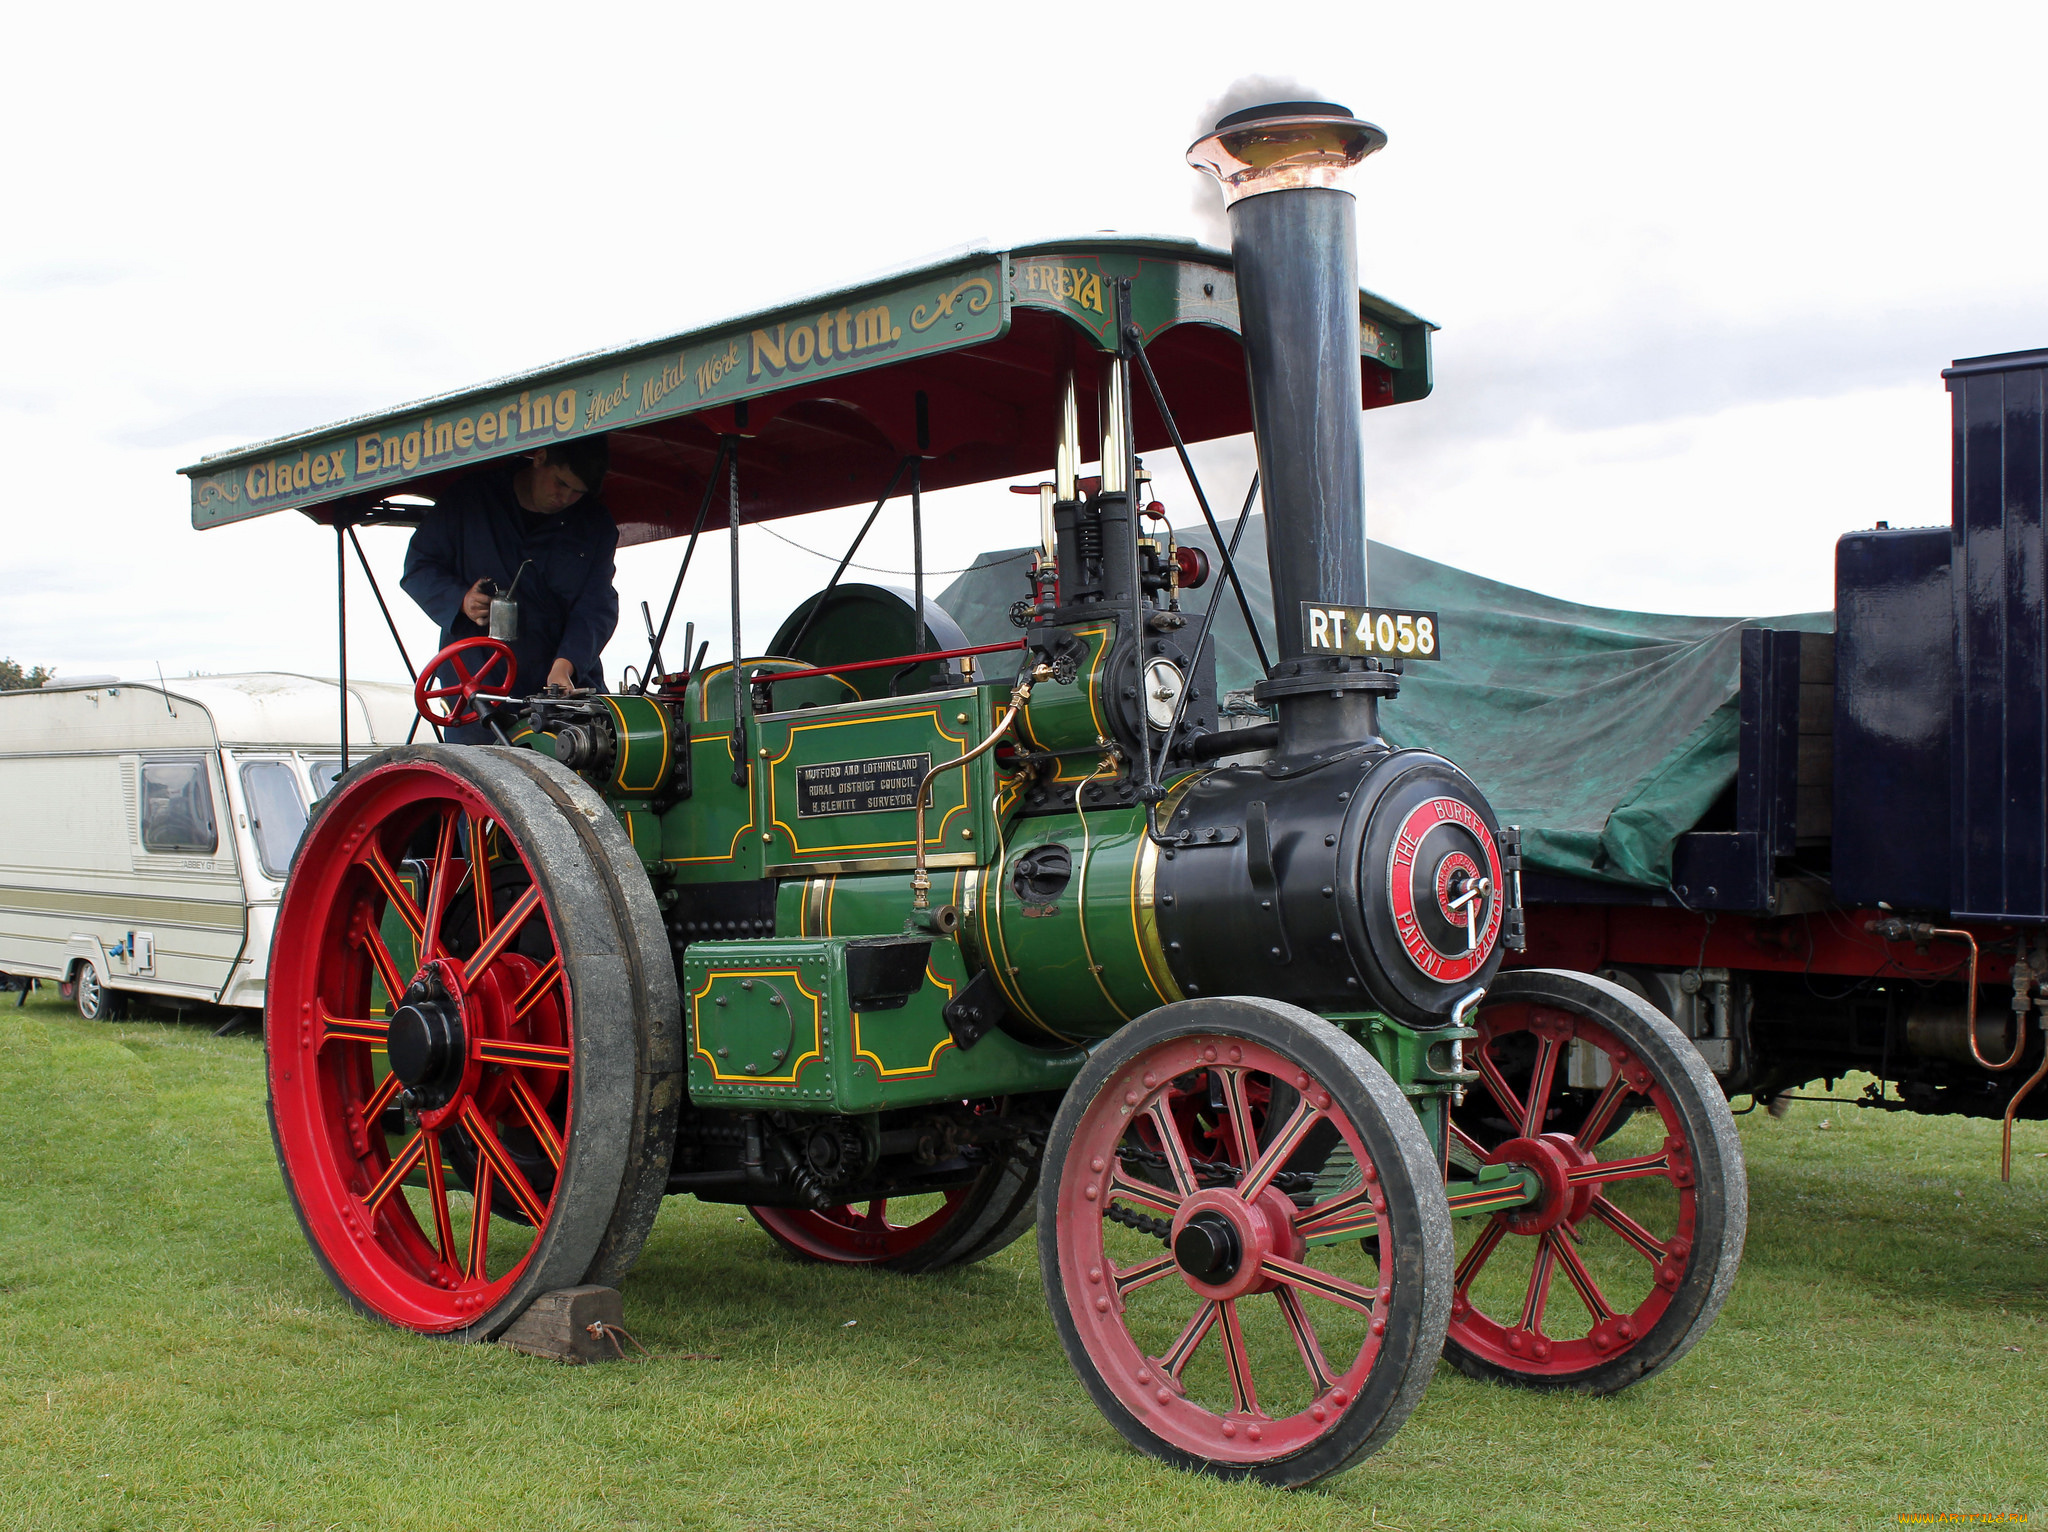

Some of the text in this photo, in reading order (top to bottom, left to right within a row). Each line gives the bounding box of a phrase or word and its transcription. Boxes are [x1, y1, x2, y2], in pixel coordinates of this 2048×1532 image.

[1026, 265, 1104, 314] FREYA
[245, 449, 346, 501] Gladex
[356, 389, 577, 474] Engineering
[635, 352, 688, 415] Metal
[695, 341, 741, 396] Work
[751, 305, 902, 376] Nottm.
[1309, 608, 1435, 654] RT 4058
[805, 758, 918, 781] MUTFORD AND LOTHINGLAND
[809, 777, 916, 796] RURAL DISTRICT COUNCIL
[867, 794, 913, 808] SURVEYOR
[1395, 801, 1495, 867] THE BURRELL
[183, 860, 217, 870] ABBEY GT
[1396, 887, 1502, 977] PATENT TRACTOR
